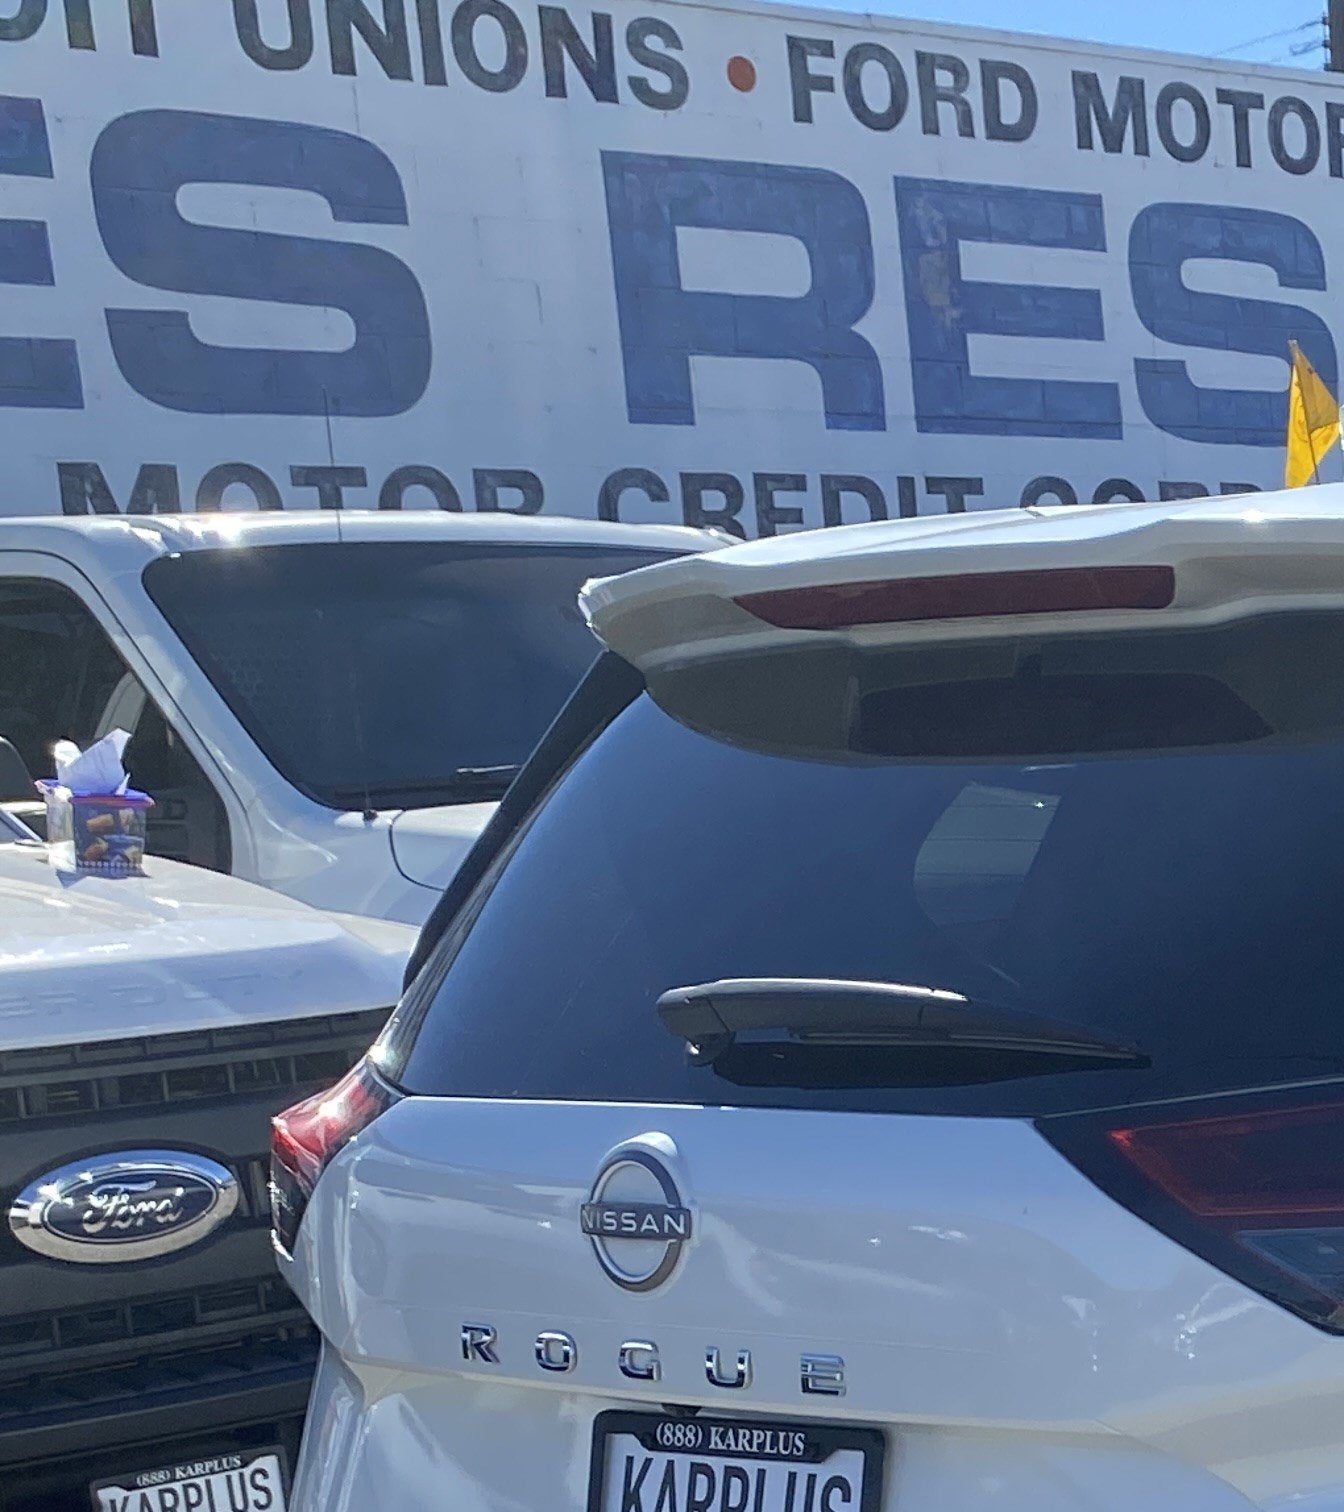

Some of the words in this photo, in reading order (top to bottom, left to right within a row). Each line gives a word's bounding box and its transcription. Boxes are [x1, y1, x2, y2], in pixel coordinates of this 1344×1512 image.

[232, 0, 690, 110] UNIONS
[786, 34, 1039, 143] FORD
[82, 1179, 184, 1234] Ford
[582, 1206, 685, 1235] NISSAN
[460, 1321, 847, 1397] ROGUE
[655, 1422, 703, 1448] (888)
[708, 1426, 806, 1456] KARPLUS
[136, 1469, 171, 1487] (888)
[174, 1455, 242, 1480] KARPLUS
